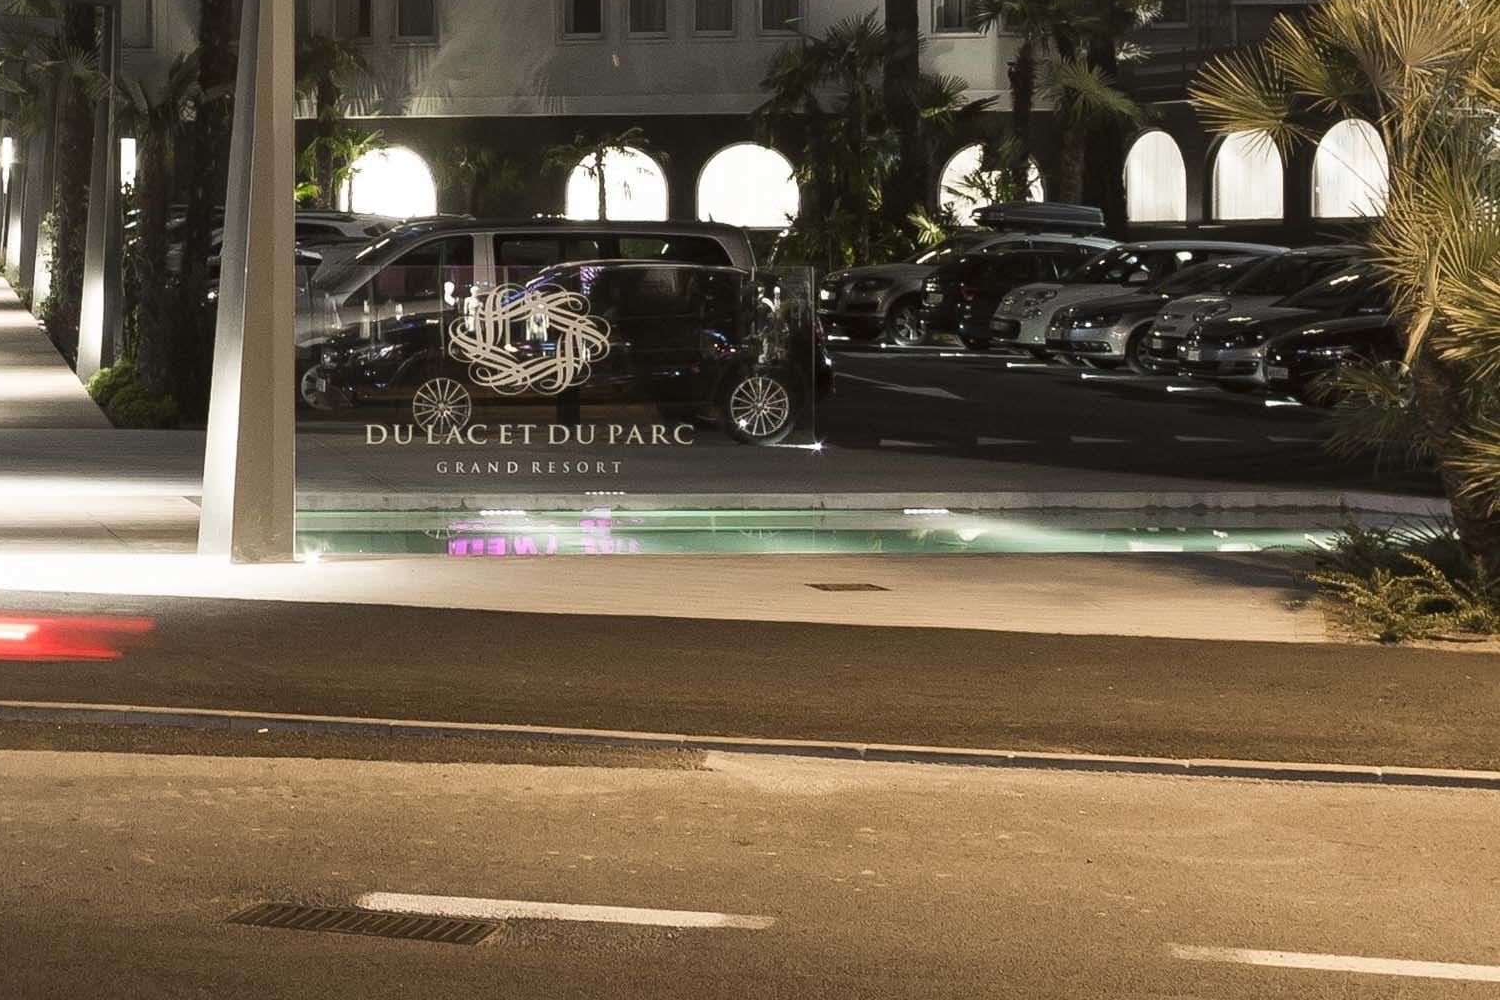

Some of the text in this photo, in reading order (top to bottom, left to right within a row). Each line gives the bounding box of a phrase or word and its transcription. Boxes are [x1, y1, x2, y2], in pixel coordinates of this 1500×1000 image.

[365, 423, 695, 446] DU LAC ET DU PARC
[436, 460, 623, 475] GRAND RESORT
